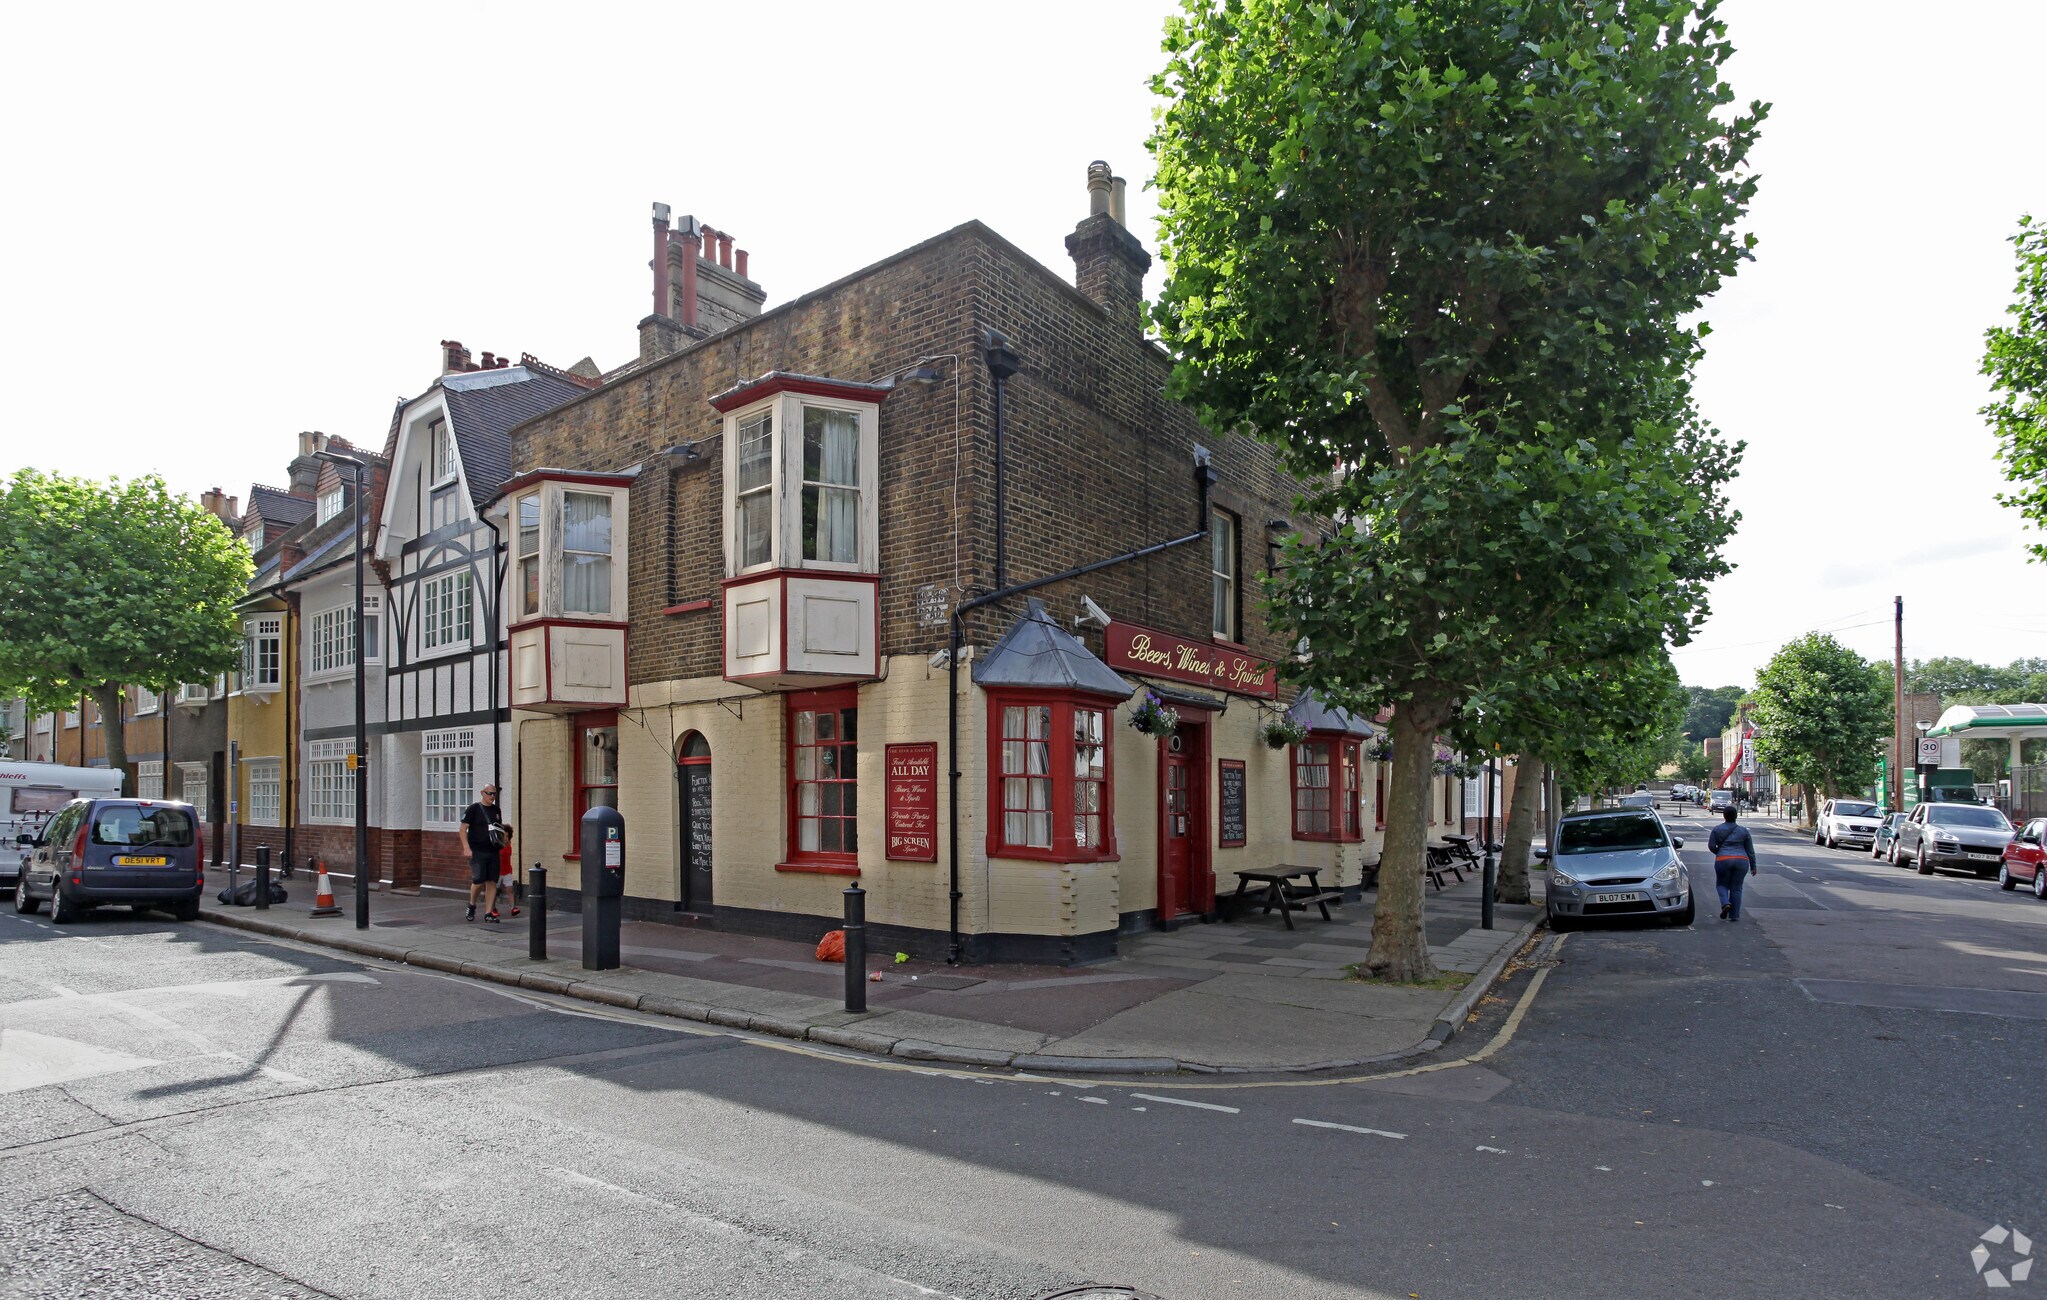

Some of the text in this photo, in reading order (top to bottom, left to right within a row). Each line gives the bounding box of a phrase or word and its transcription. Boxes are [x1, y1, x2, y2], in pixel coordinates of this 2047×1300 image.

[1128, 634, 1172, 670] Beers,
[1176, 644, 1210, 675] Wines
[1214, 660, 1226, 677] &
[891, 766, 930, 776] ALL DAY
[911, 785, 927, 793] Wines
[905, 793, 921, 803] Spirits
[891, 811, 910, 820] Private
[895, 820, 914, 828] Catered
[608, 827, 616, 839] P
[891, 836, 930, 849] BIG SCREEN
[903, 845, 918, 853] Sports
